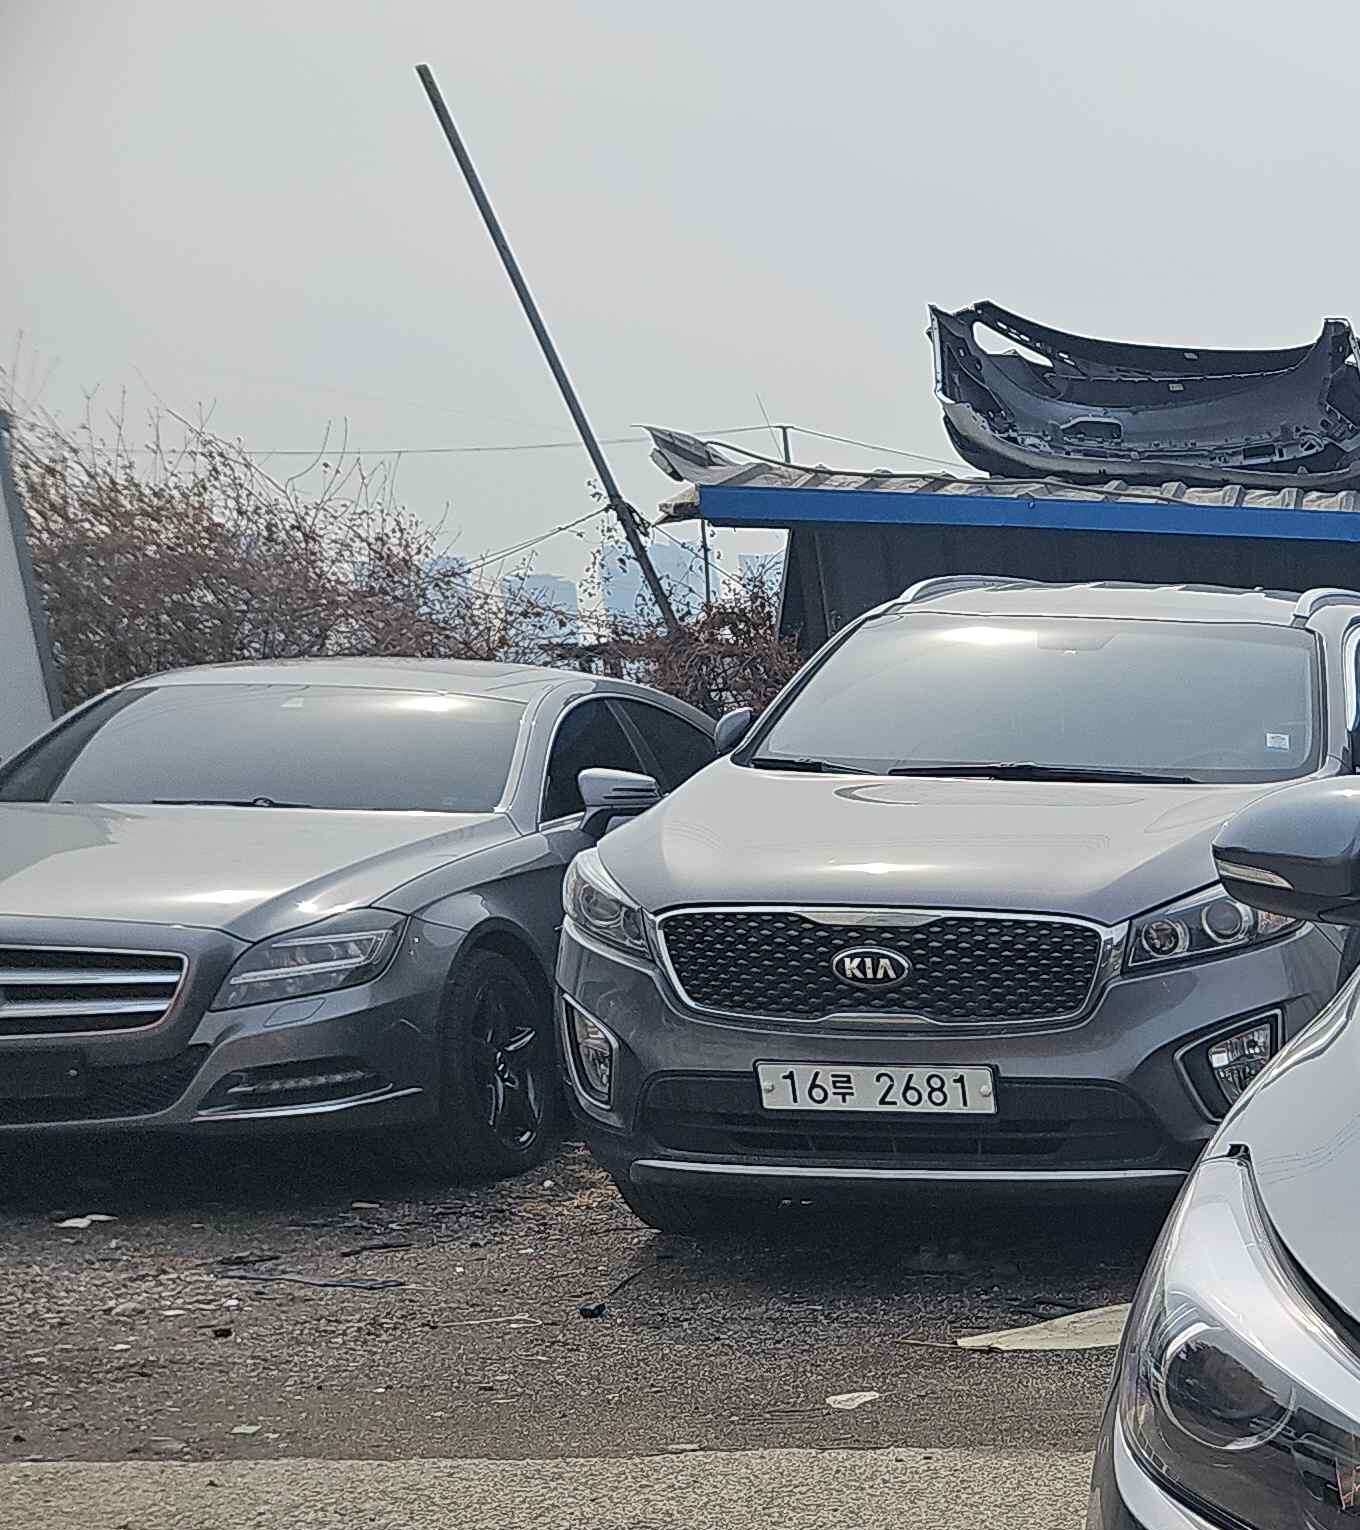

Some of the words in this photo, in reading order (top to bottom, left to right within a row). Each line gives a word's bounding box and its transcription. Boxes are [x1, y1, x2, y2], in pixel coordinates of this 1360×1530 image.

[844, 957, 897, 979] KIA
[782, 1070, 855, 1104] 16루
[875, 1072, 969, 1107] 2681
